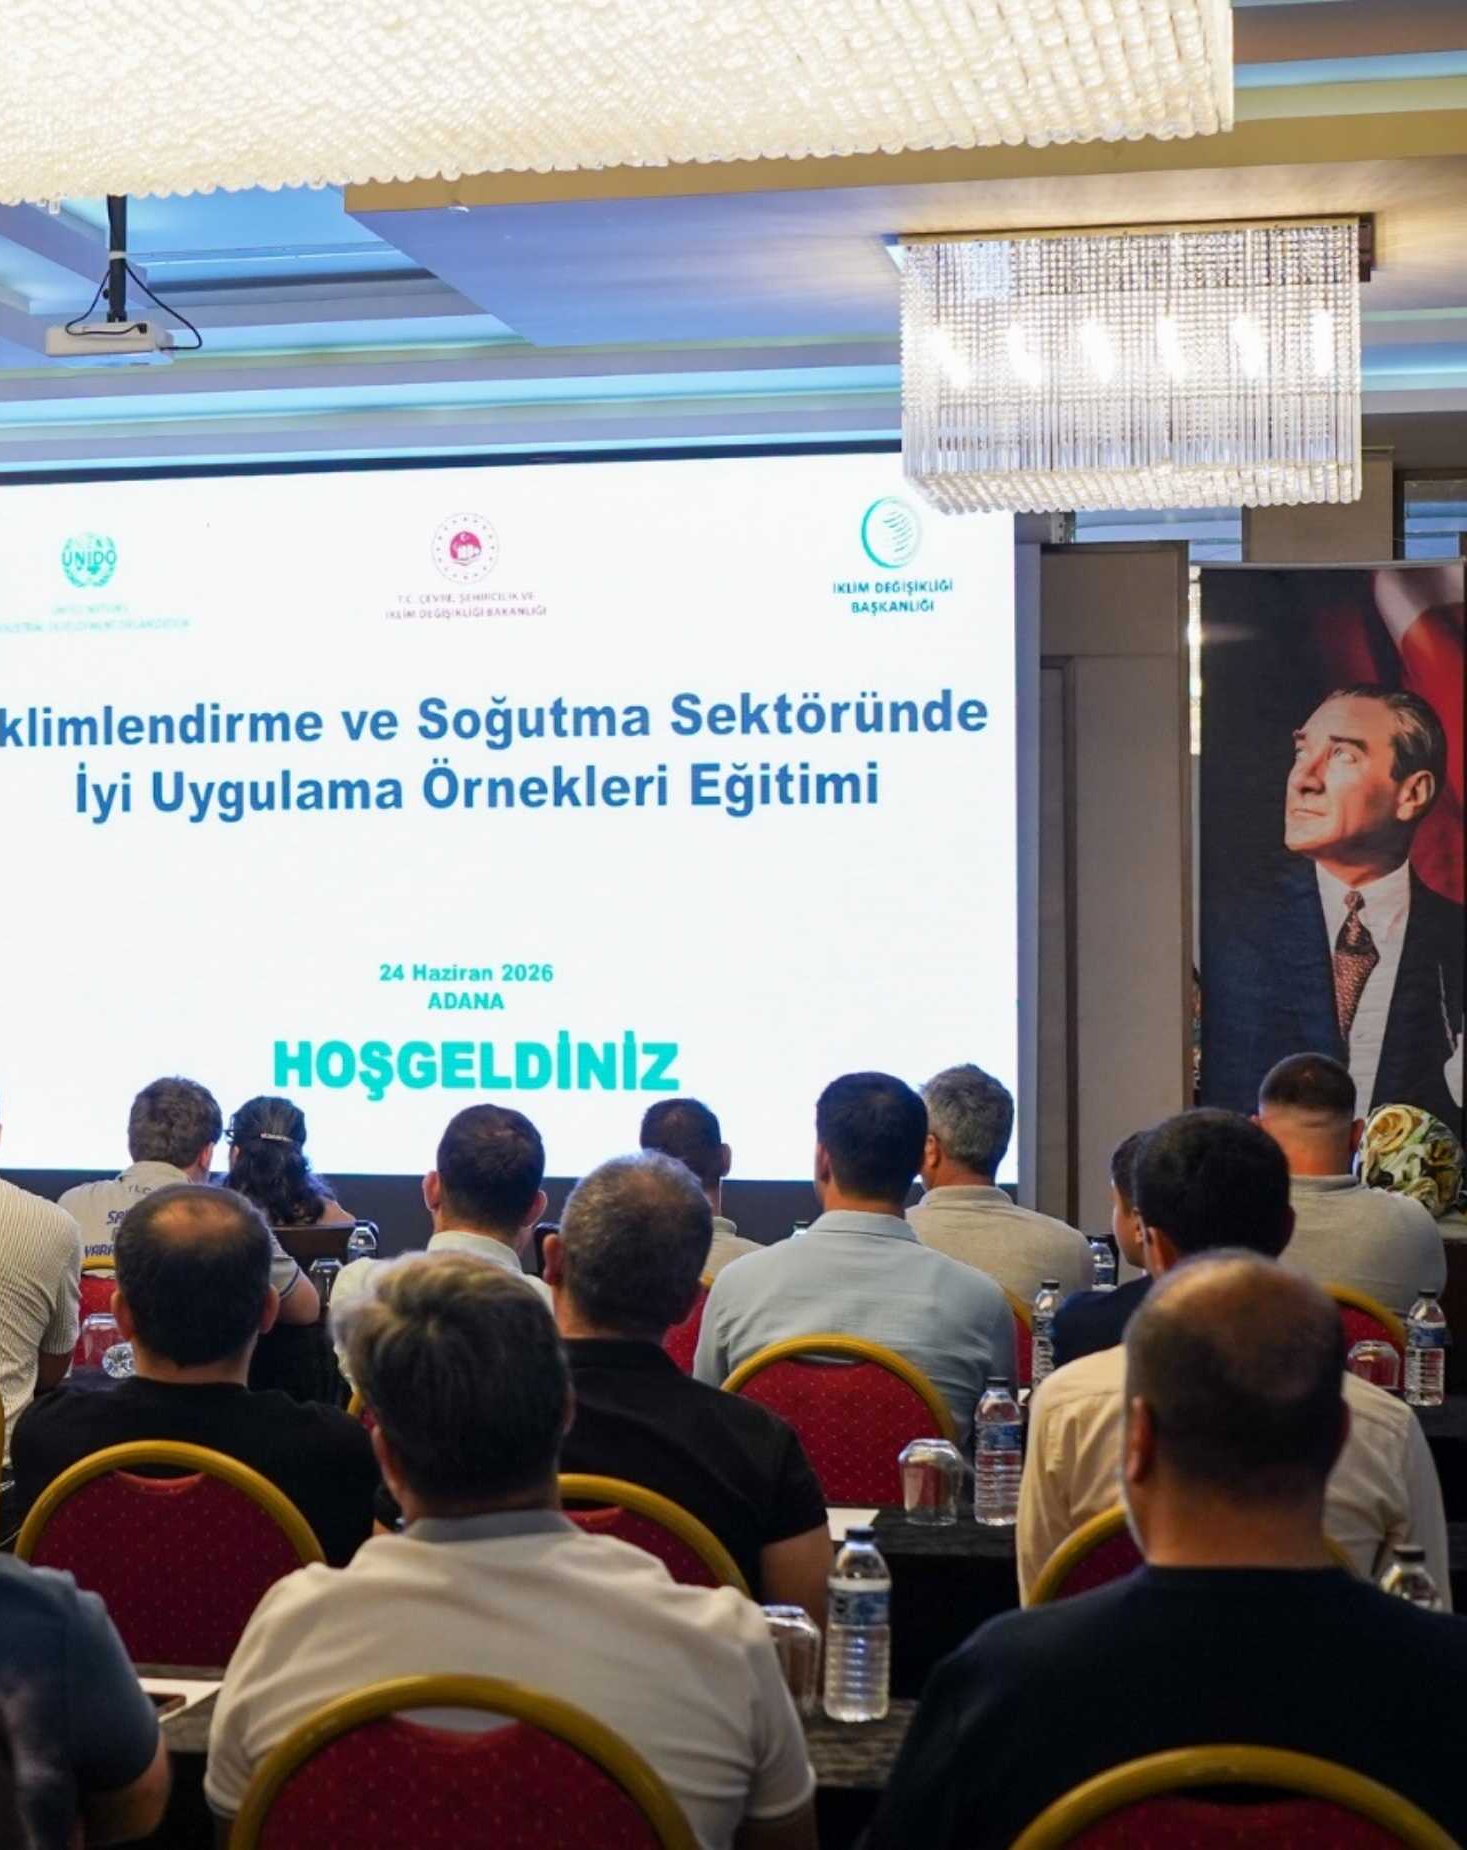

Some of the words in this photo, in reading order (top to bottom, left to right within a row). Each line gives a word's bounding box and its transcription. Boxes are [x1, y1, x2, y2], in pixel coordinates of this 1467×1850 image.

[61, 550, 118, 567] UNIDO
[340, 709, 399, 742] ve
[417, 696, 651, 751] Soğutma
[670, 688, 989, 737] Sektöründe
[76, 761, 132, 825] İyi
[151, 768, 403, 824] Uygulama
[422, 757, 668, 810] Örnekleri
[690, 760, 879, 819] Eğitimi
[379, 963, 405, 982] 24
[412, 963, 494, 983] Haziran
[501, 963, 554, 983] 2026
[427, 991, 505, 1011] ADANA
[273, 1030, 680, 1101] HOŞGELDİNİZ
